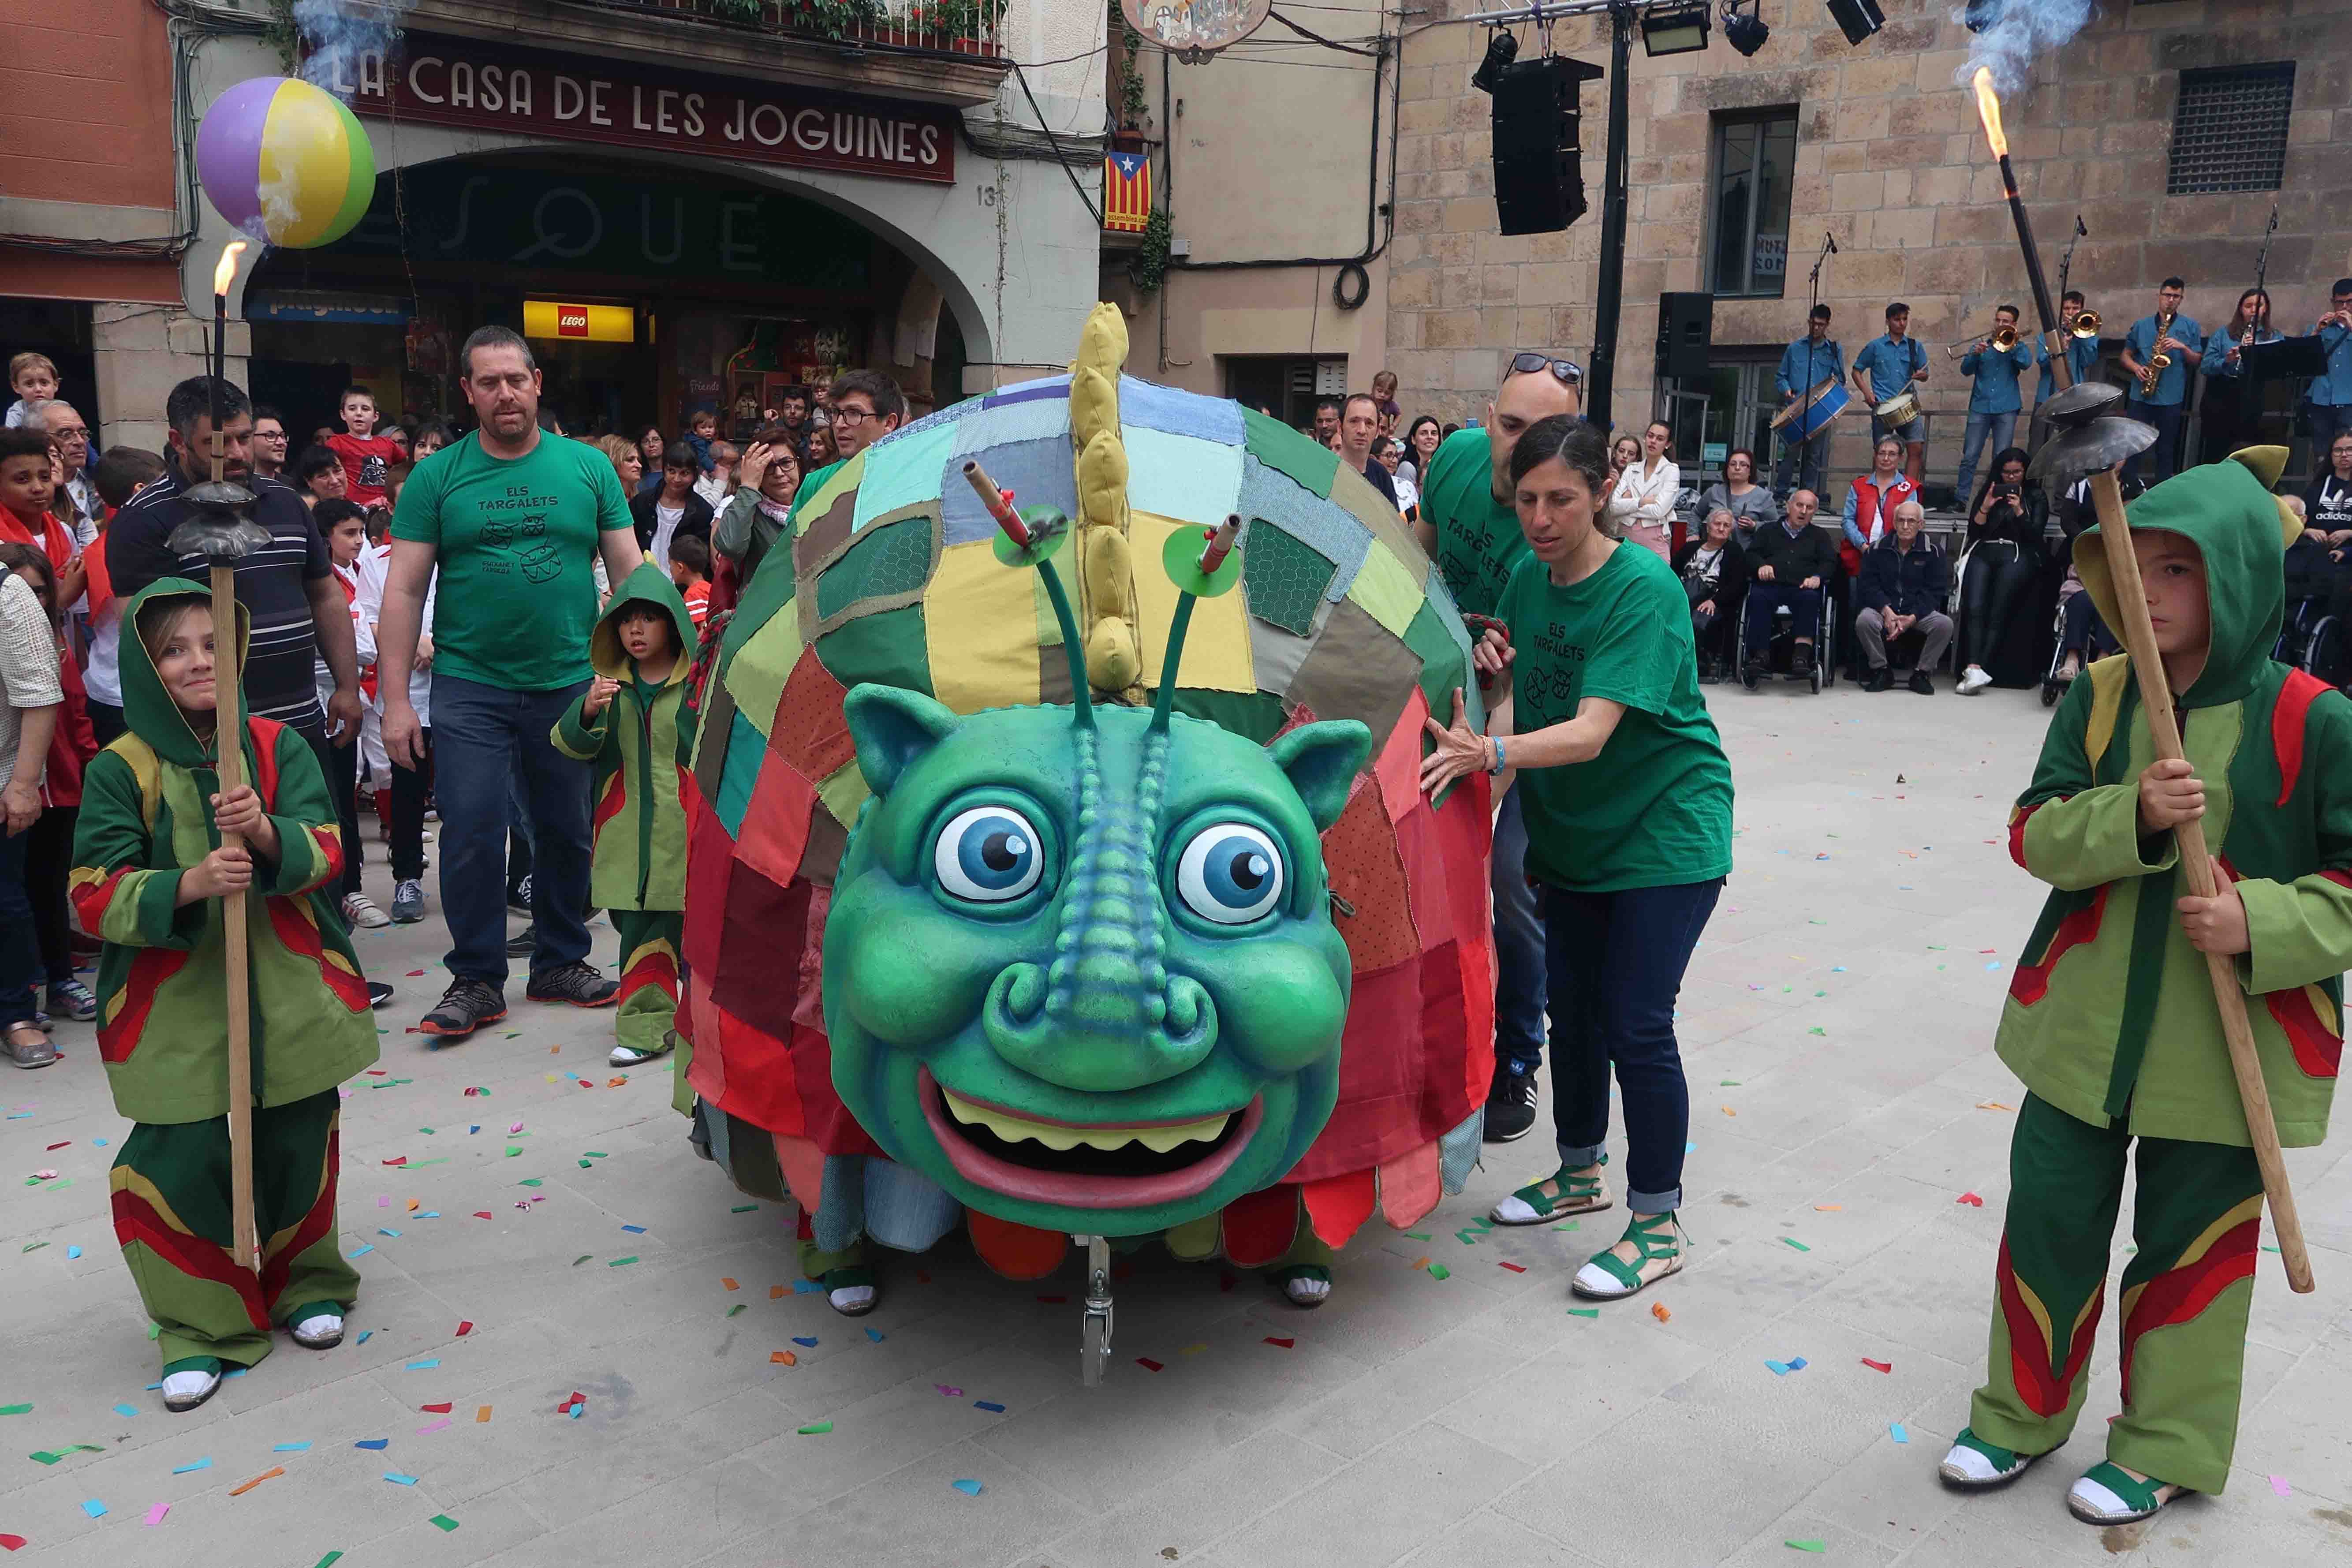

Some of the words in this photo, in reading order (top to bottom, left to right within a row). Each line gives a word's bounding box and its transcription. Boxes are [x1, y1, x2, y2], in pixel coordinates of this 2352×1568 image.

[333, 46, 385, 97] LA
[409, 57, 532, 116] CASA
[553, 75, 612, 126] DE
[632, 86, 705, 137] LES
[723, 99, 938, 165] JOGUINES
[976, 185, 994, 207] 13
[560, 315, 586, 327] LEGO
[507, 486, 529, 497] ELS
[478, 496, 559, 511] TARGALETS
[2316, 511, 2352, 521] adidas
[1447, 517, 1512, 586] TARGLETS
[1549, 621, 1566, 639] ELS
[1533, 635, 1585, 661] TARGALETS
